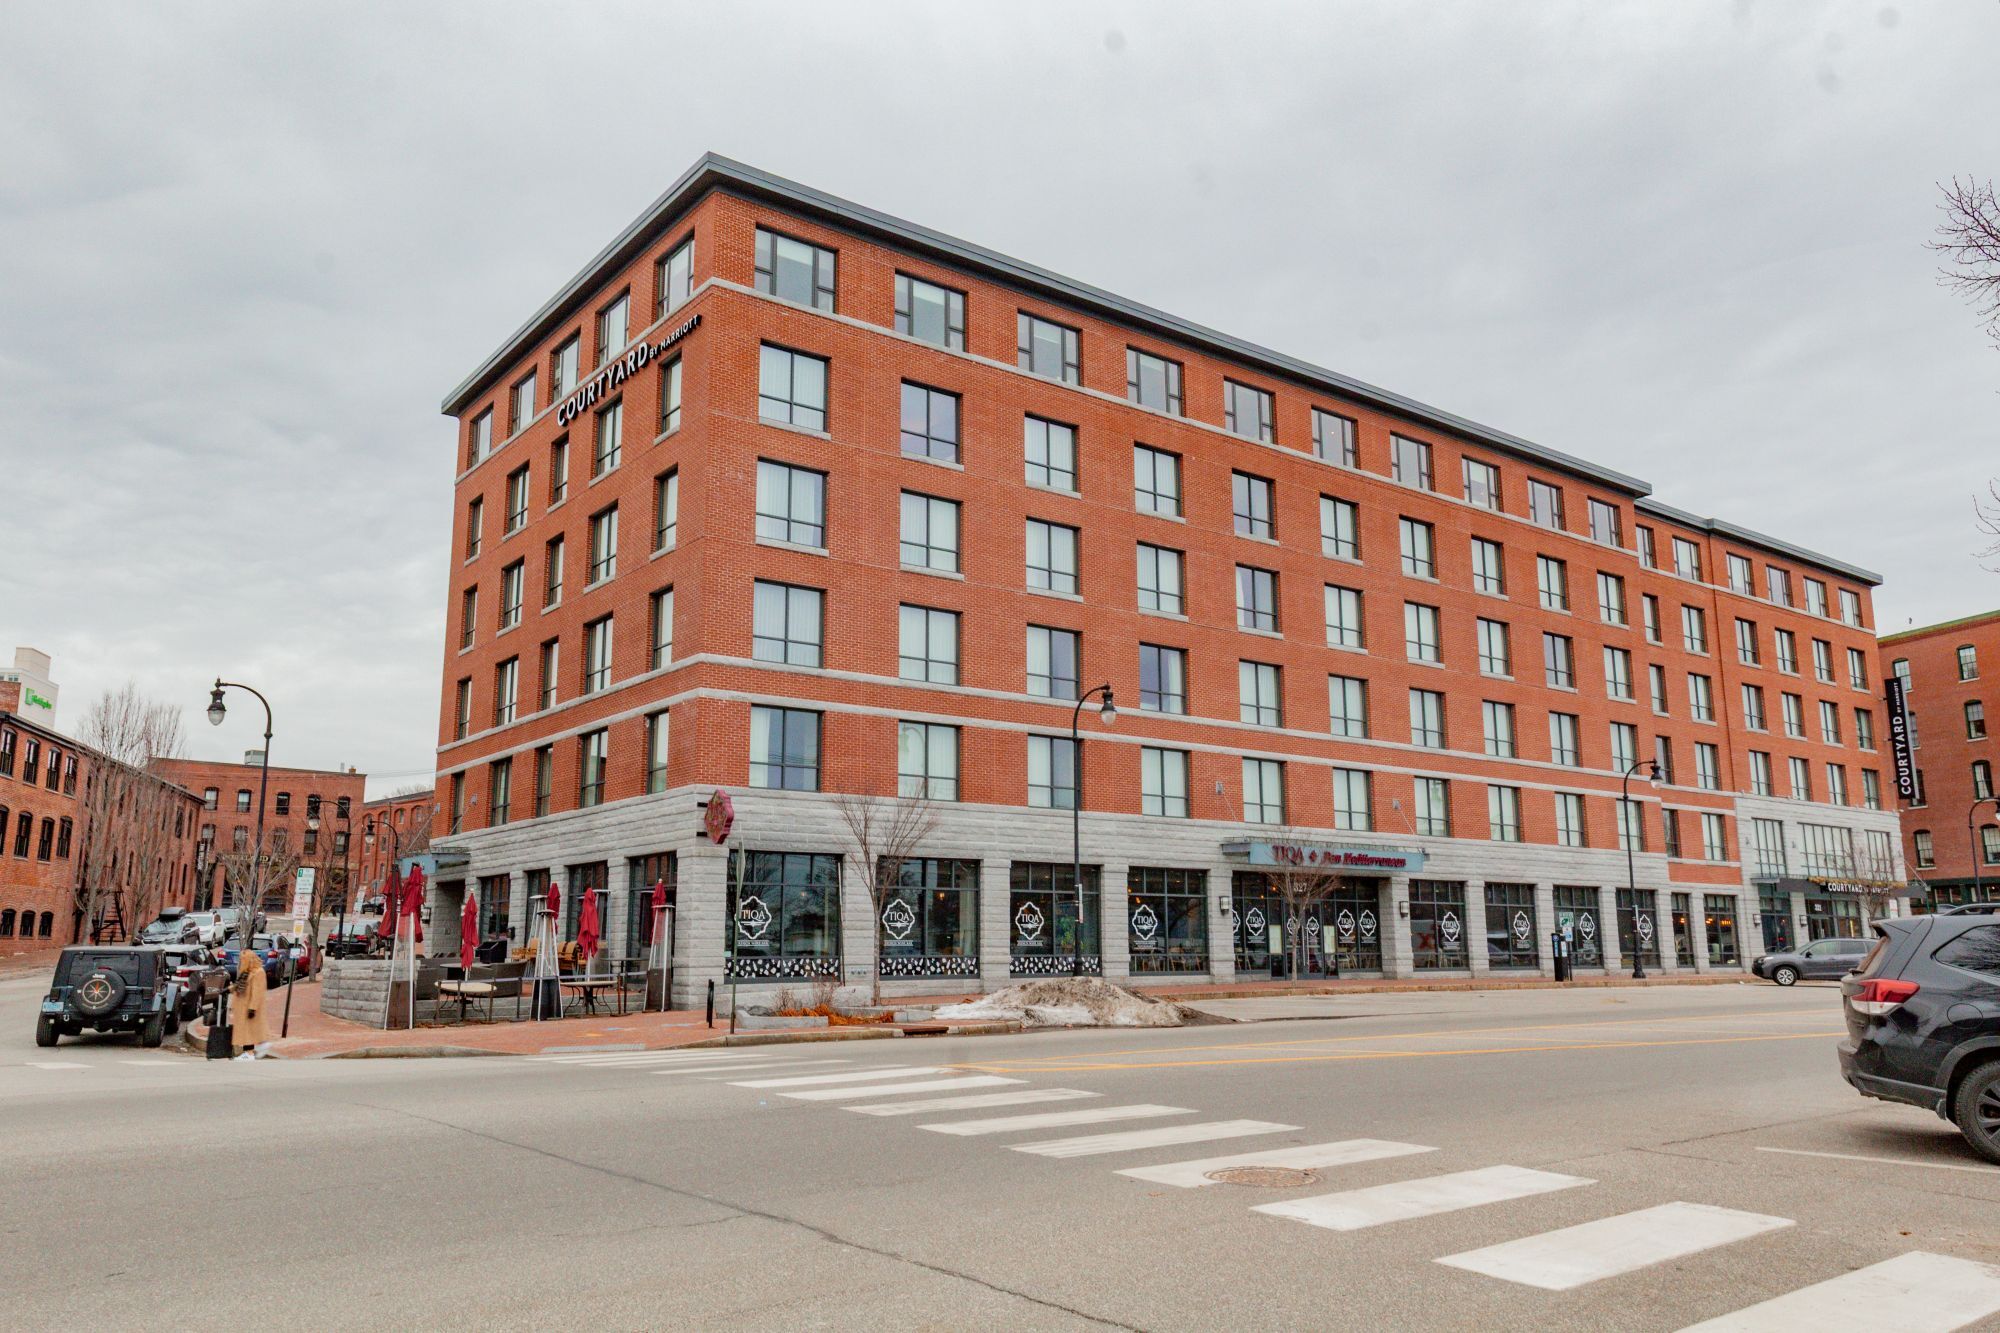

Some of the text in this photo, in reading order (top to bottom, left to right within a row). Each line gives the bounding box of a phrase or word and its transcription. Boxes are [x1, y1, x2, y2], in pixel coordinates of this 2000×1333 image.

[557, 314, 700, 426] COURTYARD BY MARRIOTT
[1893, 716, 1912, 795] COURTYARD
[1272, 845, 1305, 865] TIQA
[1828, 883, 1863, 893] COURTYARD
[741, 910, 765, 921] TIQA
[889, 911, 910, 923] TIQA
[1020, 913, 1040, 925] TIQA
[1136, 915, 1154, 926] TIQA
[1249, 916, 1262, 925] TIQA
[1341, 917, 1353, 926] TIQA
[1445, 920, 1457, 929] TIQA
